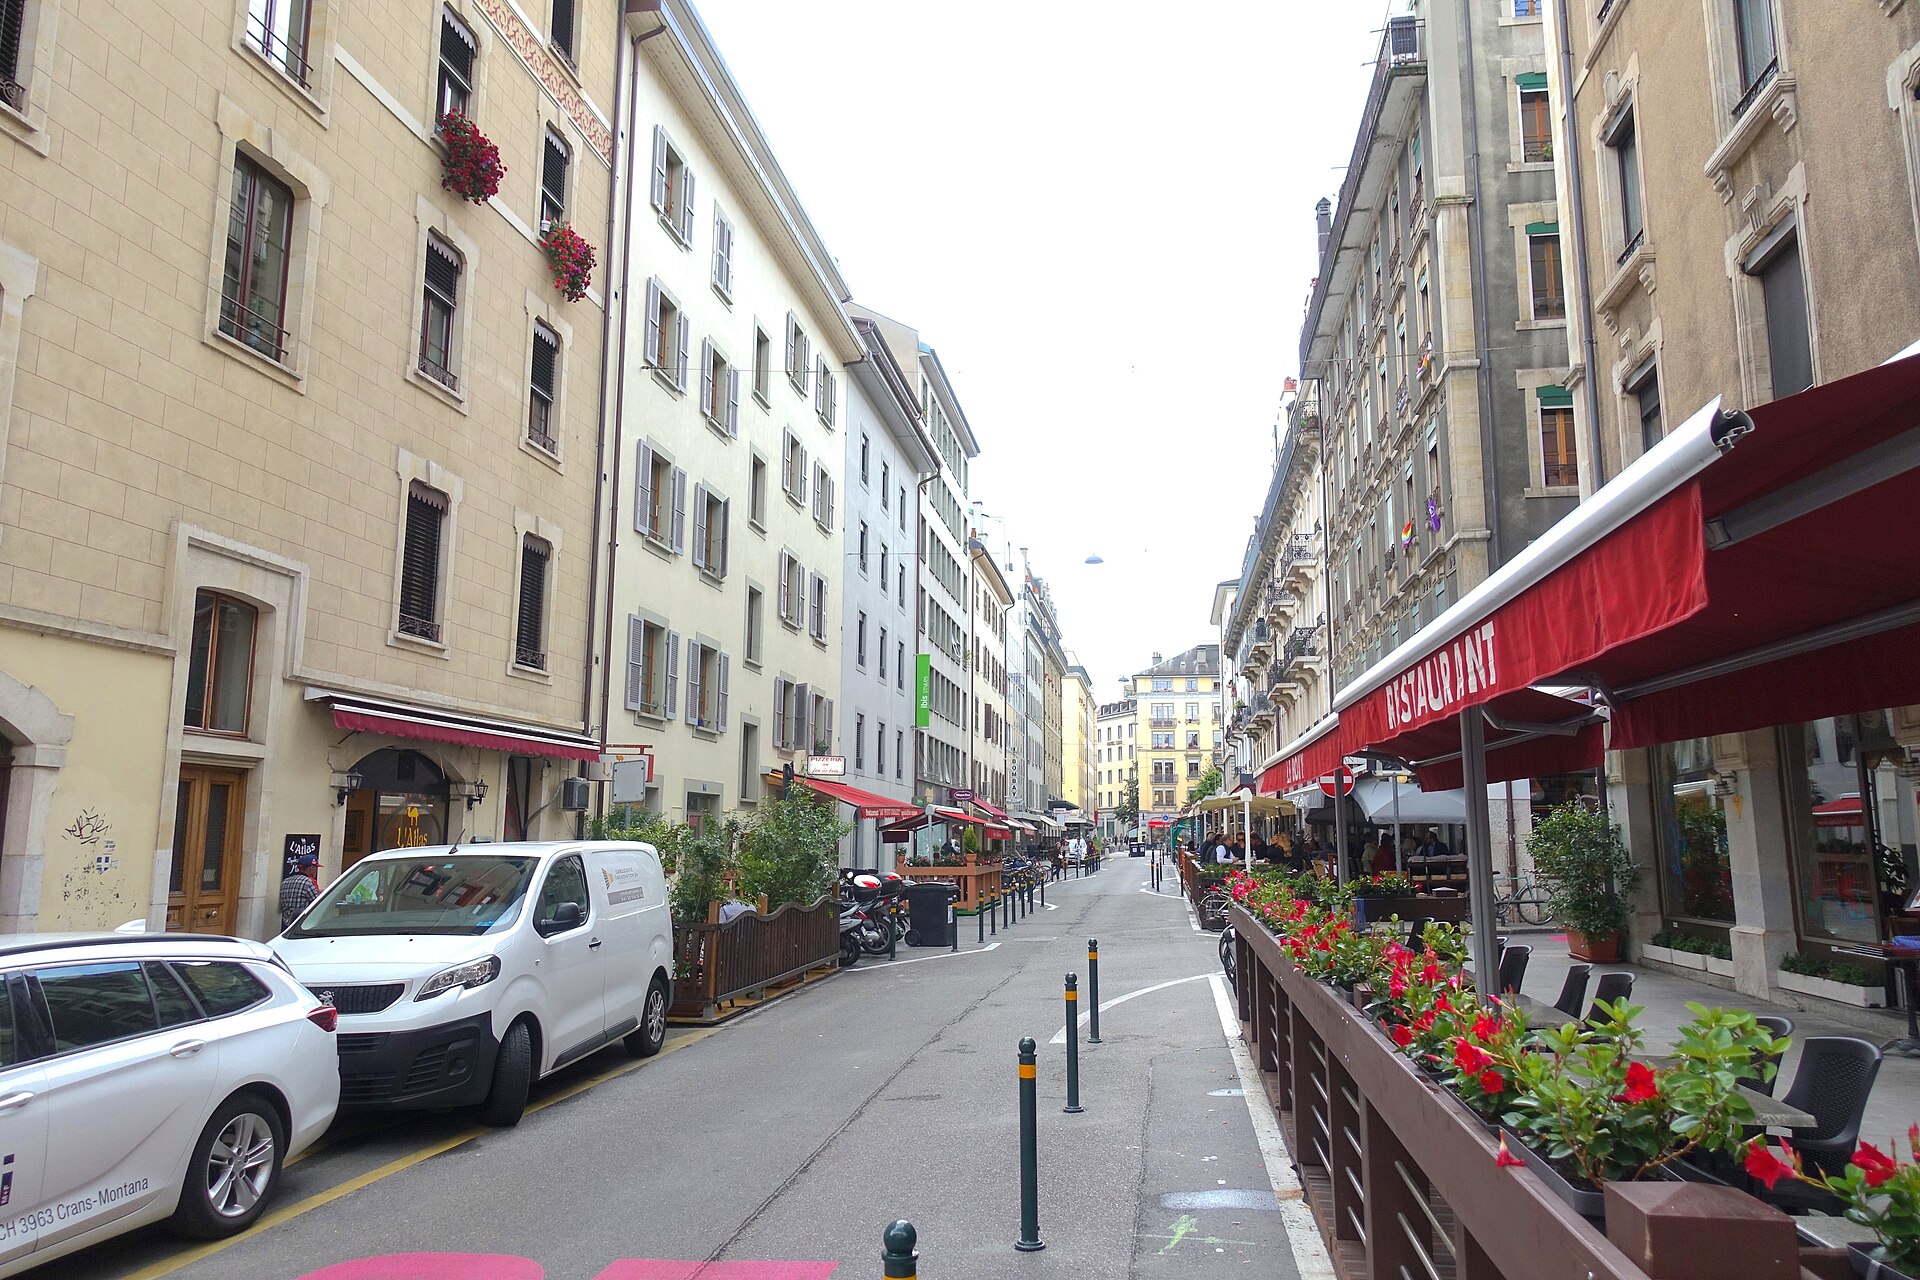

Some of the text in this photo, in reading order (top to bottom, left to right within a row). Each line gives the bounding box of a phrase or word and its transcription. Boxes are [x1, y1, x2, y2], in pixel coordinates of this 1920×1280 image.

[1385, 620, 1497, 730] RESTAURANT
[920, 695, 928, 709] ibis
[289, 840, 316, 855] L'Atlas
[397, 827, 428, 848] L'Atlas
[0, 1177, 149, 1241] CH 3963 Crans-Montana
